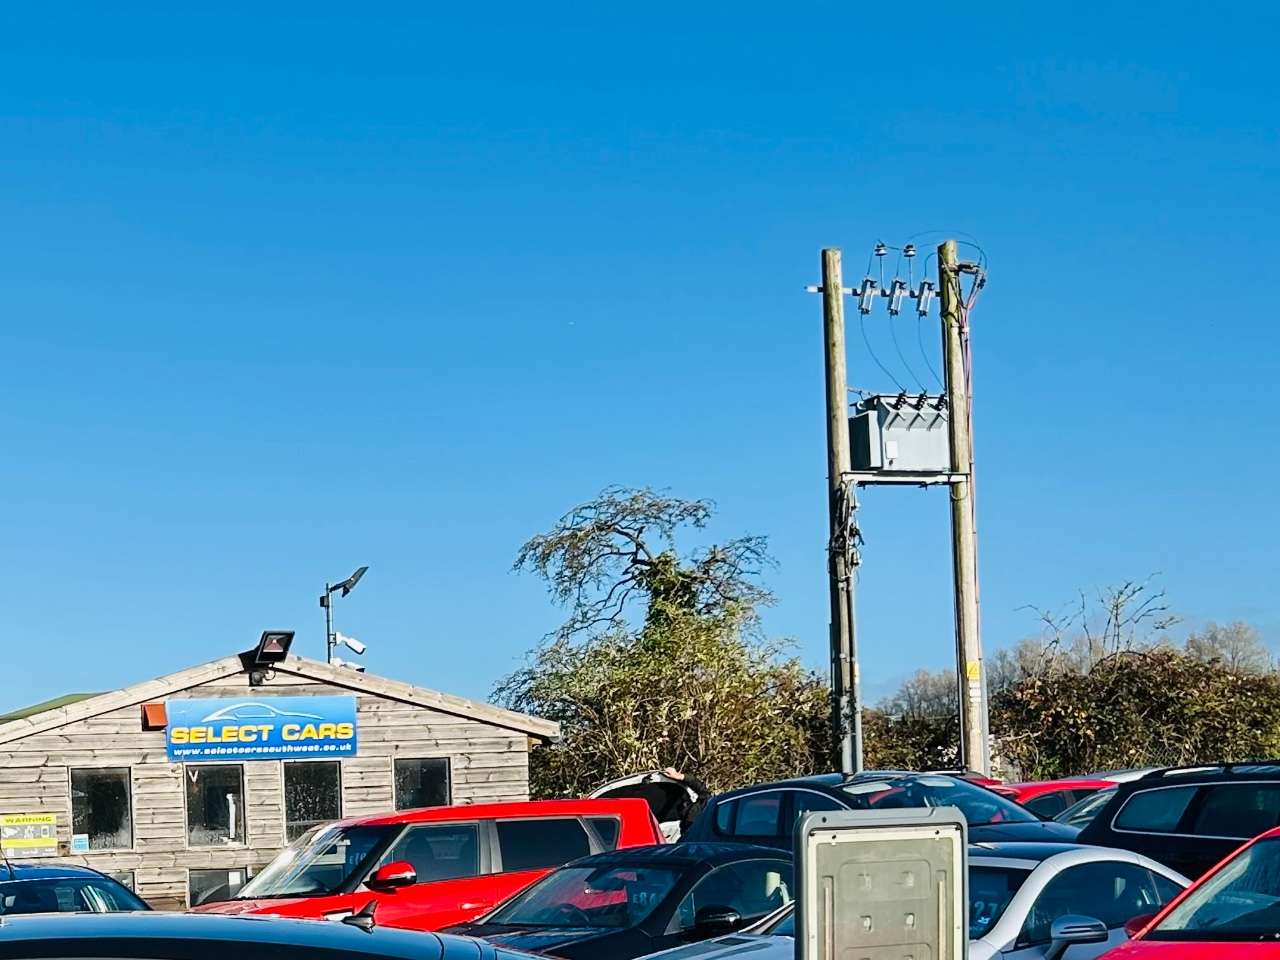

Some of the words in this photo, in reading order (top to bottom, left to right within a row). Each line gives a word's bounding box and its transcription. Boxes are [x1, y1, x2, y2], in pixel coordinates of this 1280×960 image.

[171, 725, 274, 744] SELECT
[281, 722, 354, 741] CARS
[5, 816, 52, 824] WARNING
